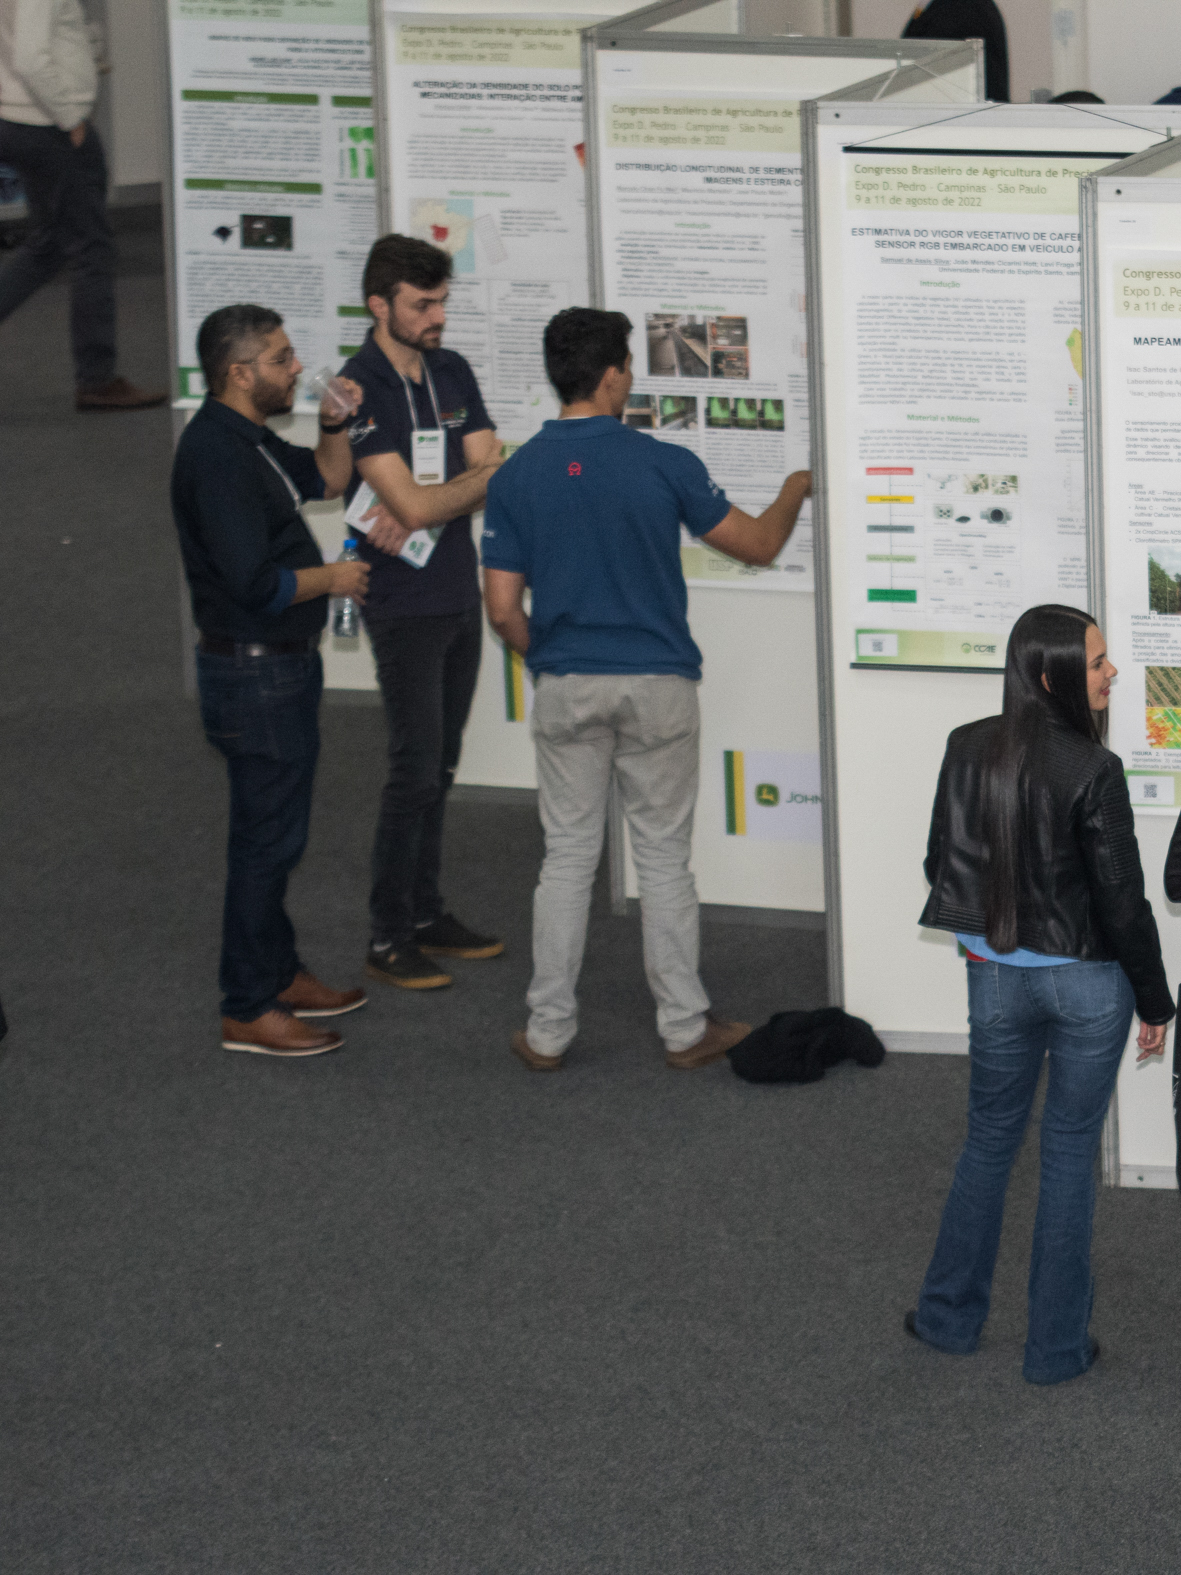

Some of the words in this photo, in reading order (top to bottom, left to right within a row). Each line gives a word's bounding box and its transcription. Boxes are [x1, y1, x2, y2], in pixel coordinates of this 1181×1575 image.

[851, 227, 911, 236] ESTIMATIVA
[913, 229, 929, 237] DO
[931, 229, 964, 238] VIGOR
[966, 230, 1031, 240] VEGETATIVO
[1033, 232, 1046, 240] DE
[875, 240, 917, 248] SENSOR
[919, 241, 941, 249] RGB
[943, 242, 1009, 251] EMBARCADO
[1011, 244, 1027, 252] EM
[1029, 243, 1074, 253] VEÍCULO
[1123, 268, 1181, 281] Congresso
